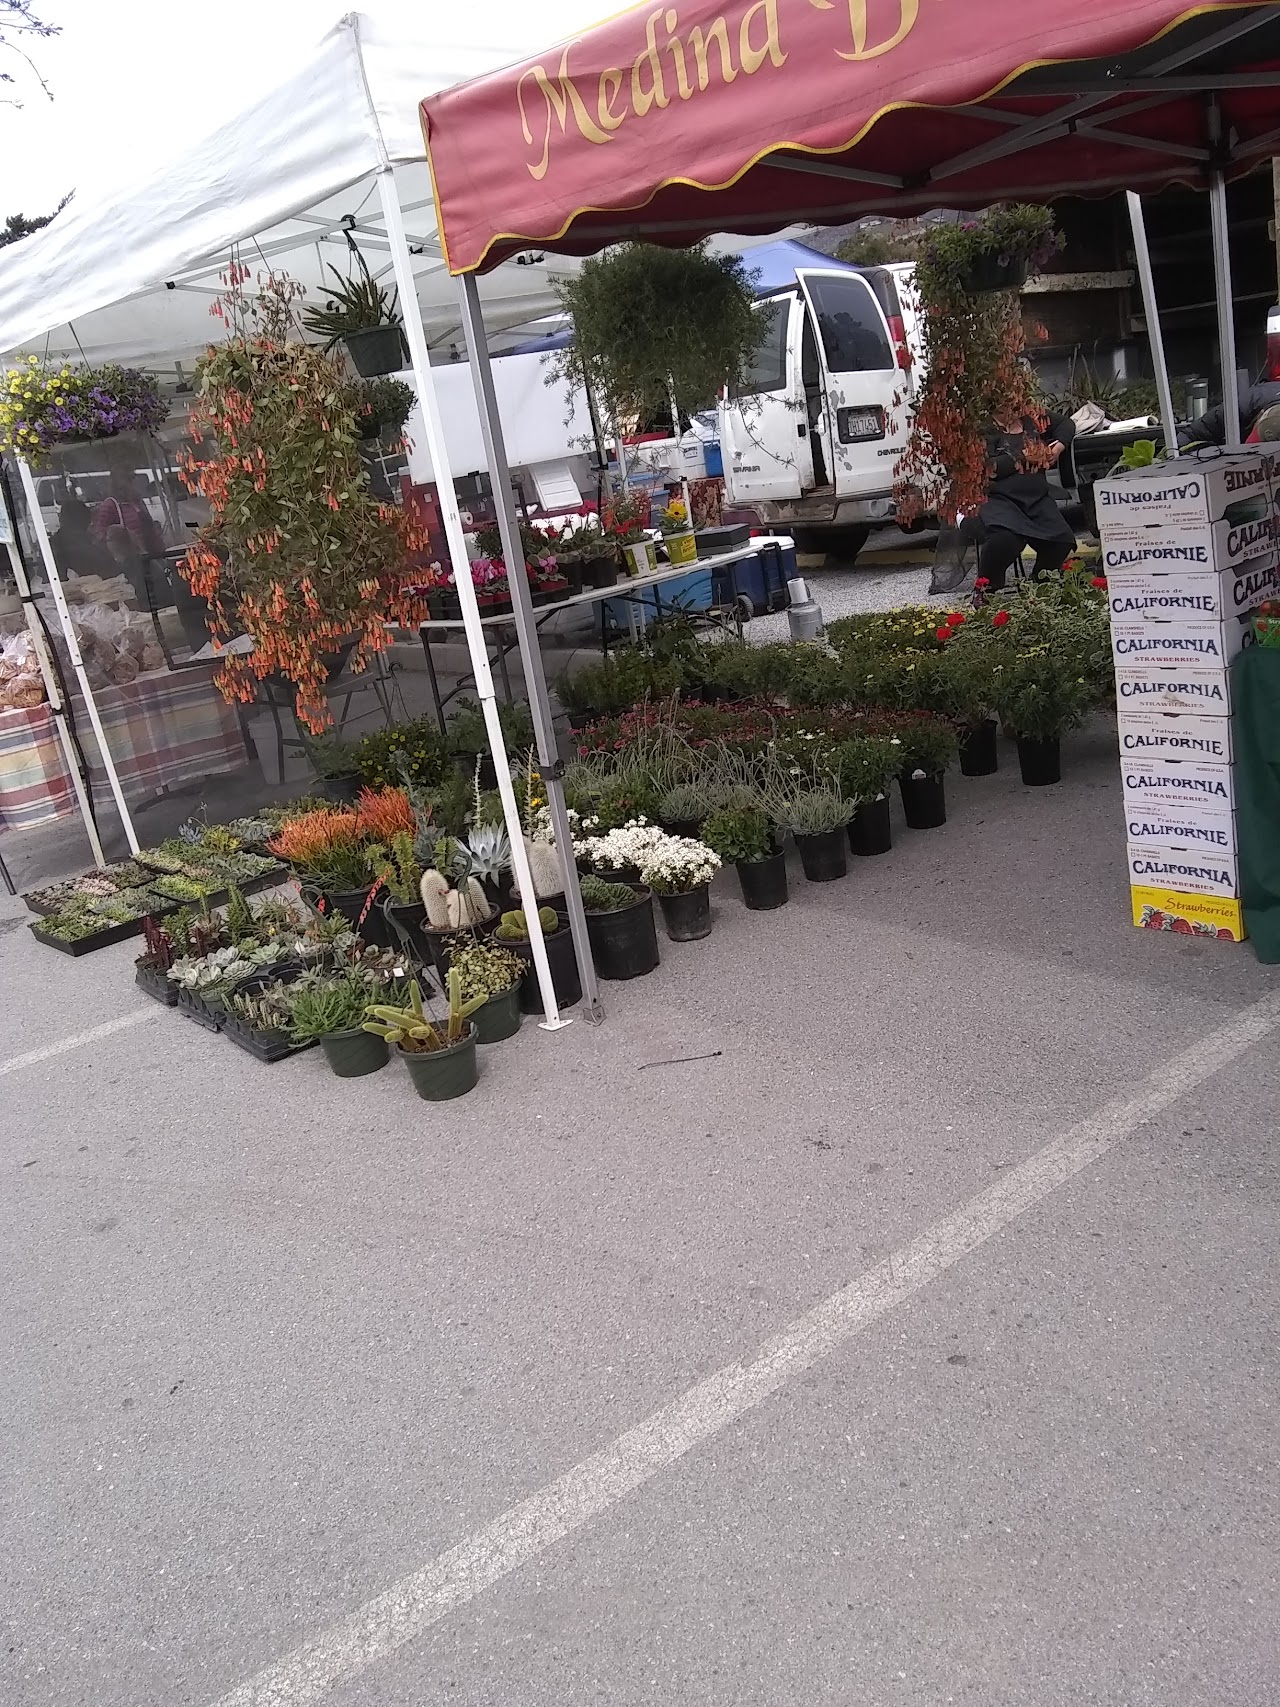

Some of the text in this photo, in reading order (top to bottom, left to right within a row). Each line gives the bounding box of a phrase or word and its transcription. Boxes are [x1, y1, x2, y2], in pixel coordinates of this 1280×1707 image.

[516, 0, 789, 181] Medina
[1099, 481, 1200, 506] CALIFORNIE
[1106, 546, 1208, 567] CALIFORNIE
[1112, 596, 1216, 613] CALIFORNIE
[1116, 639, 1219, 656] CALIFORNIA
[1120, 682, 1224, 701] CALIFORNIA
[1124, 734, 1224, 756] CALIFORNIE
[1126, 775, 1229, 798] CALIFORNIA
[1143, 792, 1209, 802] STRAWBERRIES
[1129, 822, 1229, 846] CALIFORNIE
[1132, 860, 1234, 888] CALIFORNIA
[1150, 878, 1215, 891] STRAWBERRIES
[1164, 898, 1234, 917] Strawberries
